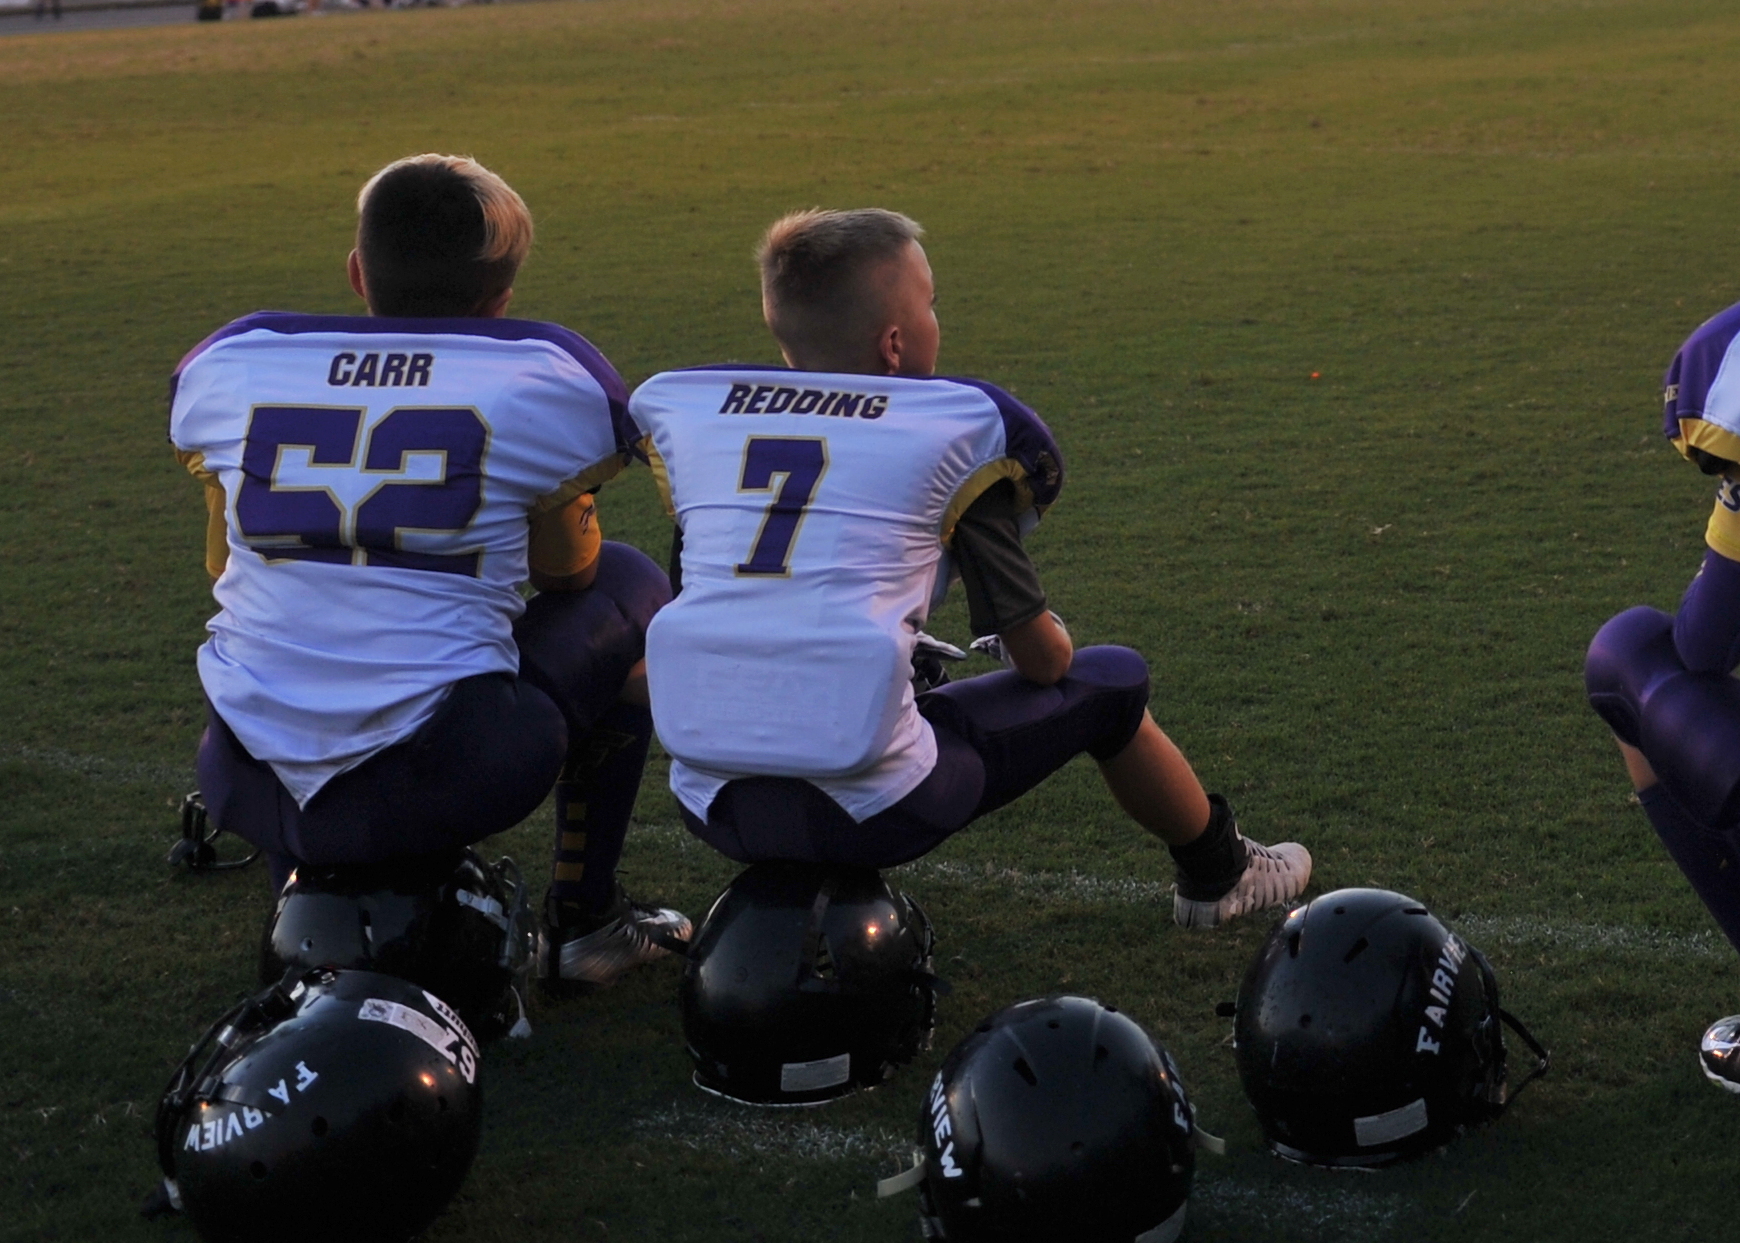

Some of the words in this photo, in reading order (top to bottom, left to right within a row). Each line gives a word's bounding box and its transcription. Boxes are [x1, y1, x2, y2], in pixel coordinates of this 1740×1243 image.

[328, 352, 434, 387] CARR
[717, 383, 889, 420] REDDING
[234, 402, 492, 578] 52
[733, 434, 829, 578] 7
[183, 1060, 320, 1153] FARVIEW
